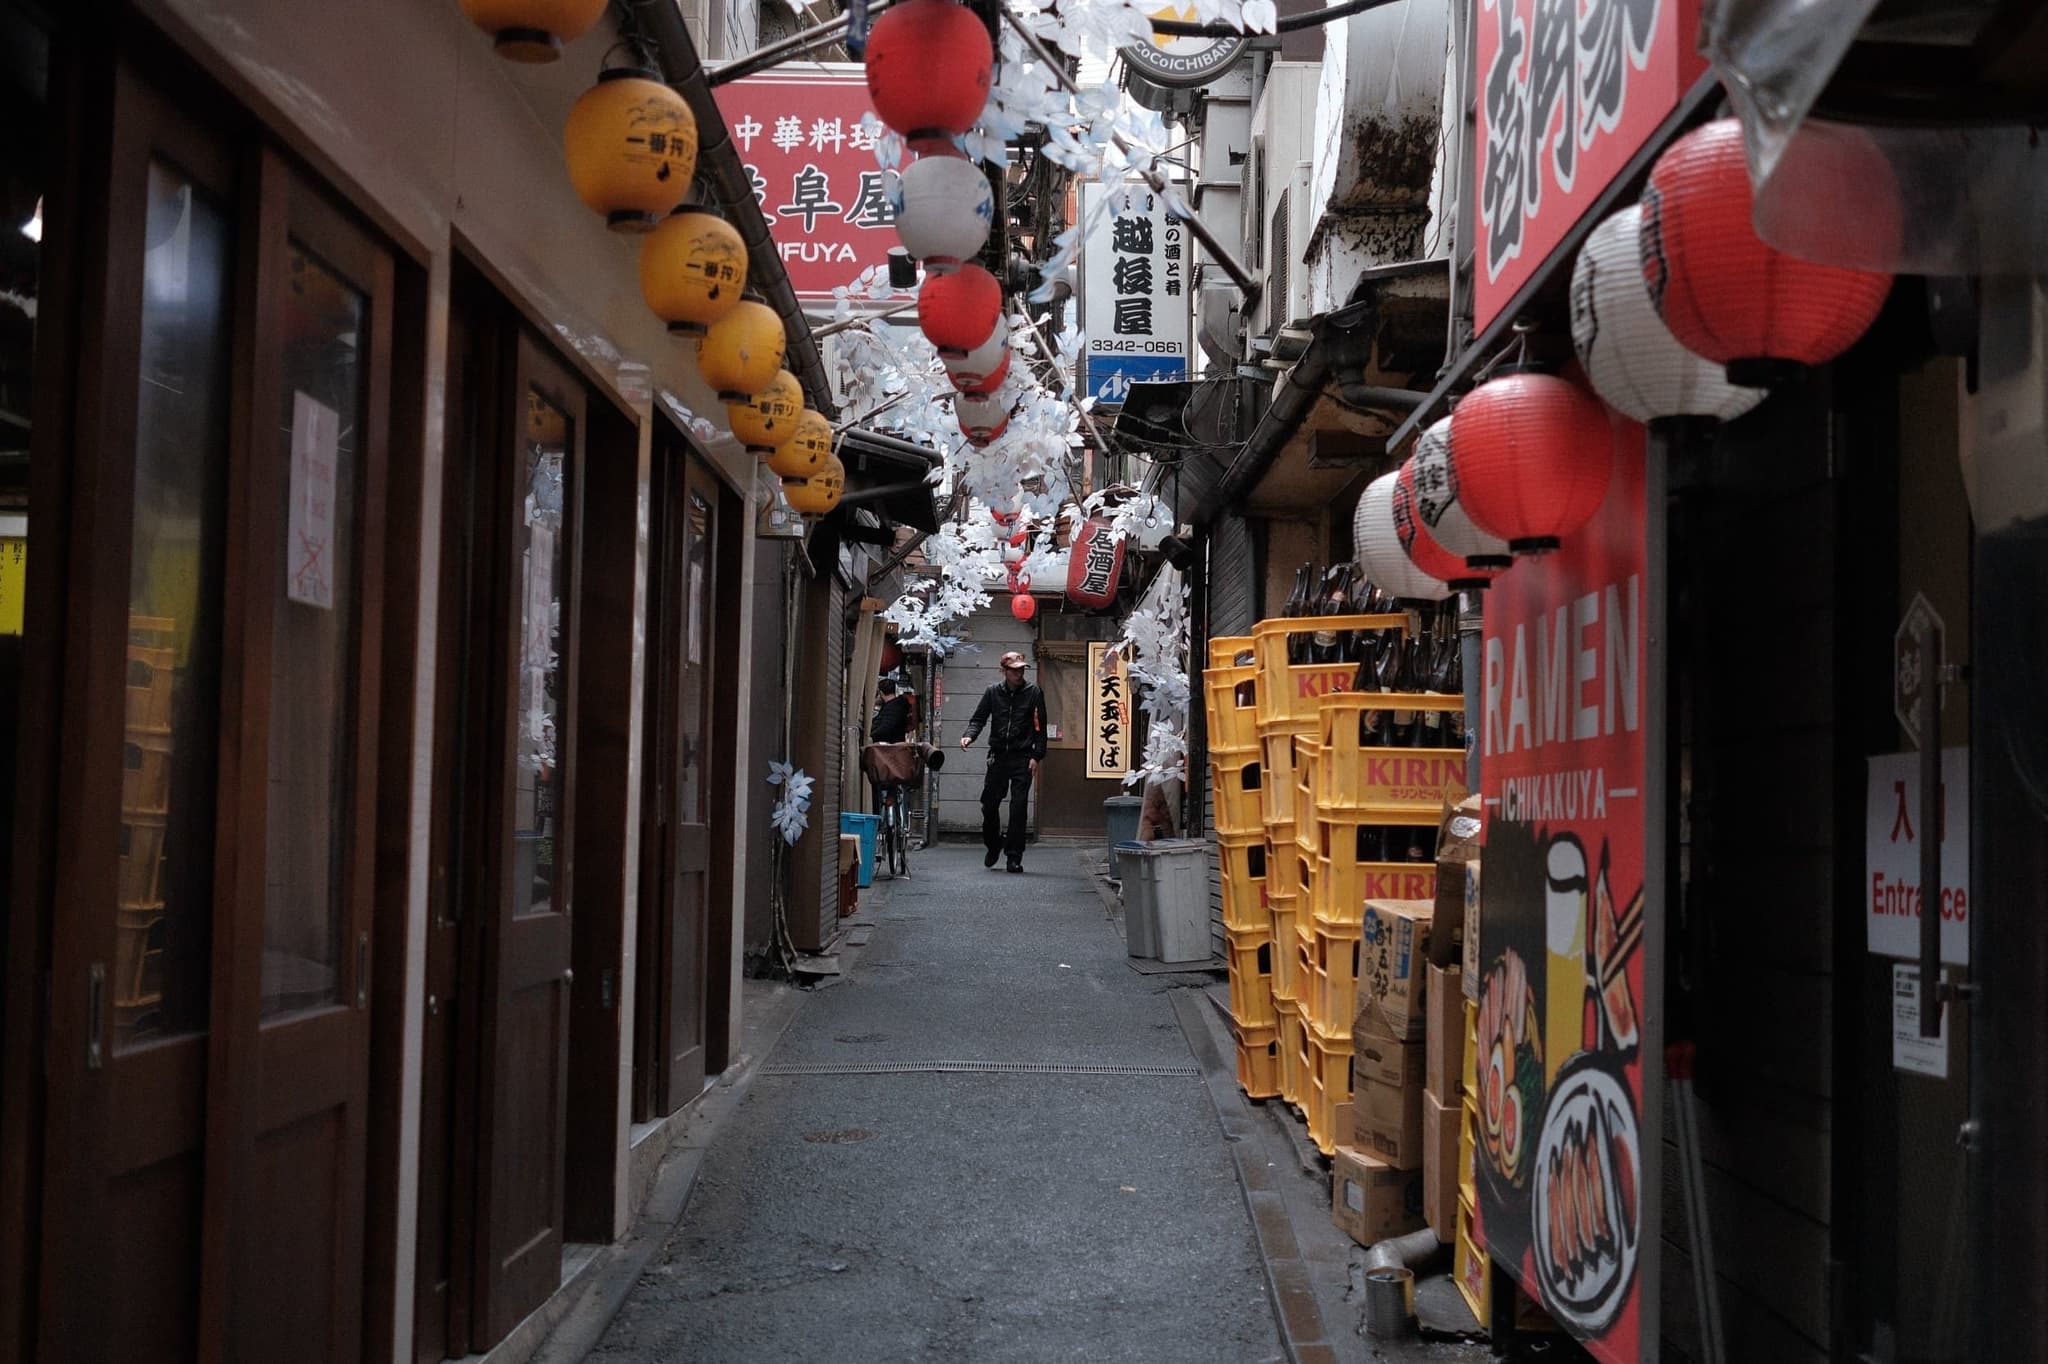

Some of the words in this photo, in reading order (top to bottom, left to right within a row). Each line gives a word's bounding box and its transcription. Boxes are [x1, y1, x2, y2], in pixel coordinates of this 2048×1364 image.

[625, 132, 692, 161] 一番搾り
[734, 114, 885, 155] 中華料理
[777, 241, 857, 263] IFUYA
[685, 262, 742, 285] 一番搾り
[1112, 215, 1154, 336] 越後屋
[1091, 340, 1183, 354] 3342-0661
[747, 400, 795, 417] 一番搾り
[1080, 525, 1117, 597] 居酒屋
[1485, 574, 1640, 757] RAMEN
[1098, 675, 1121, 768] 天玉そば
[1367, 758, 1467, 786] KIRIN
[1500, 767, 1608, 822] ICHIKAKUYA
[1872, 871, 1967, 924] Entrace
